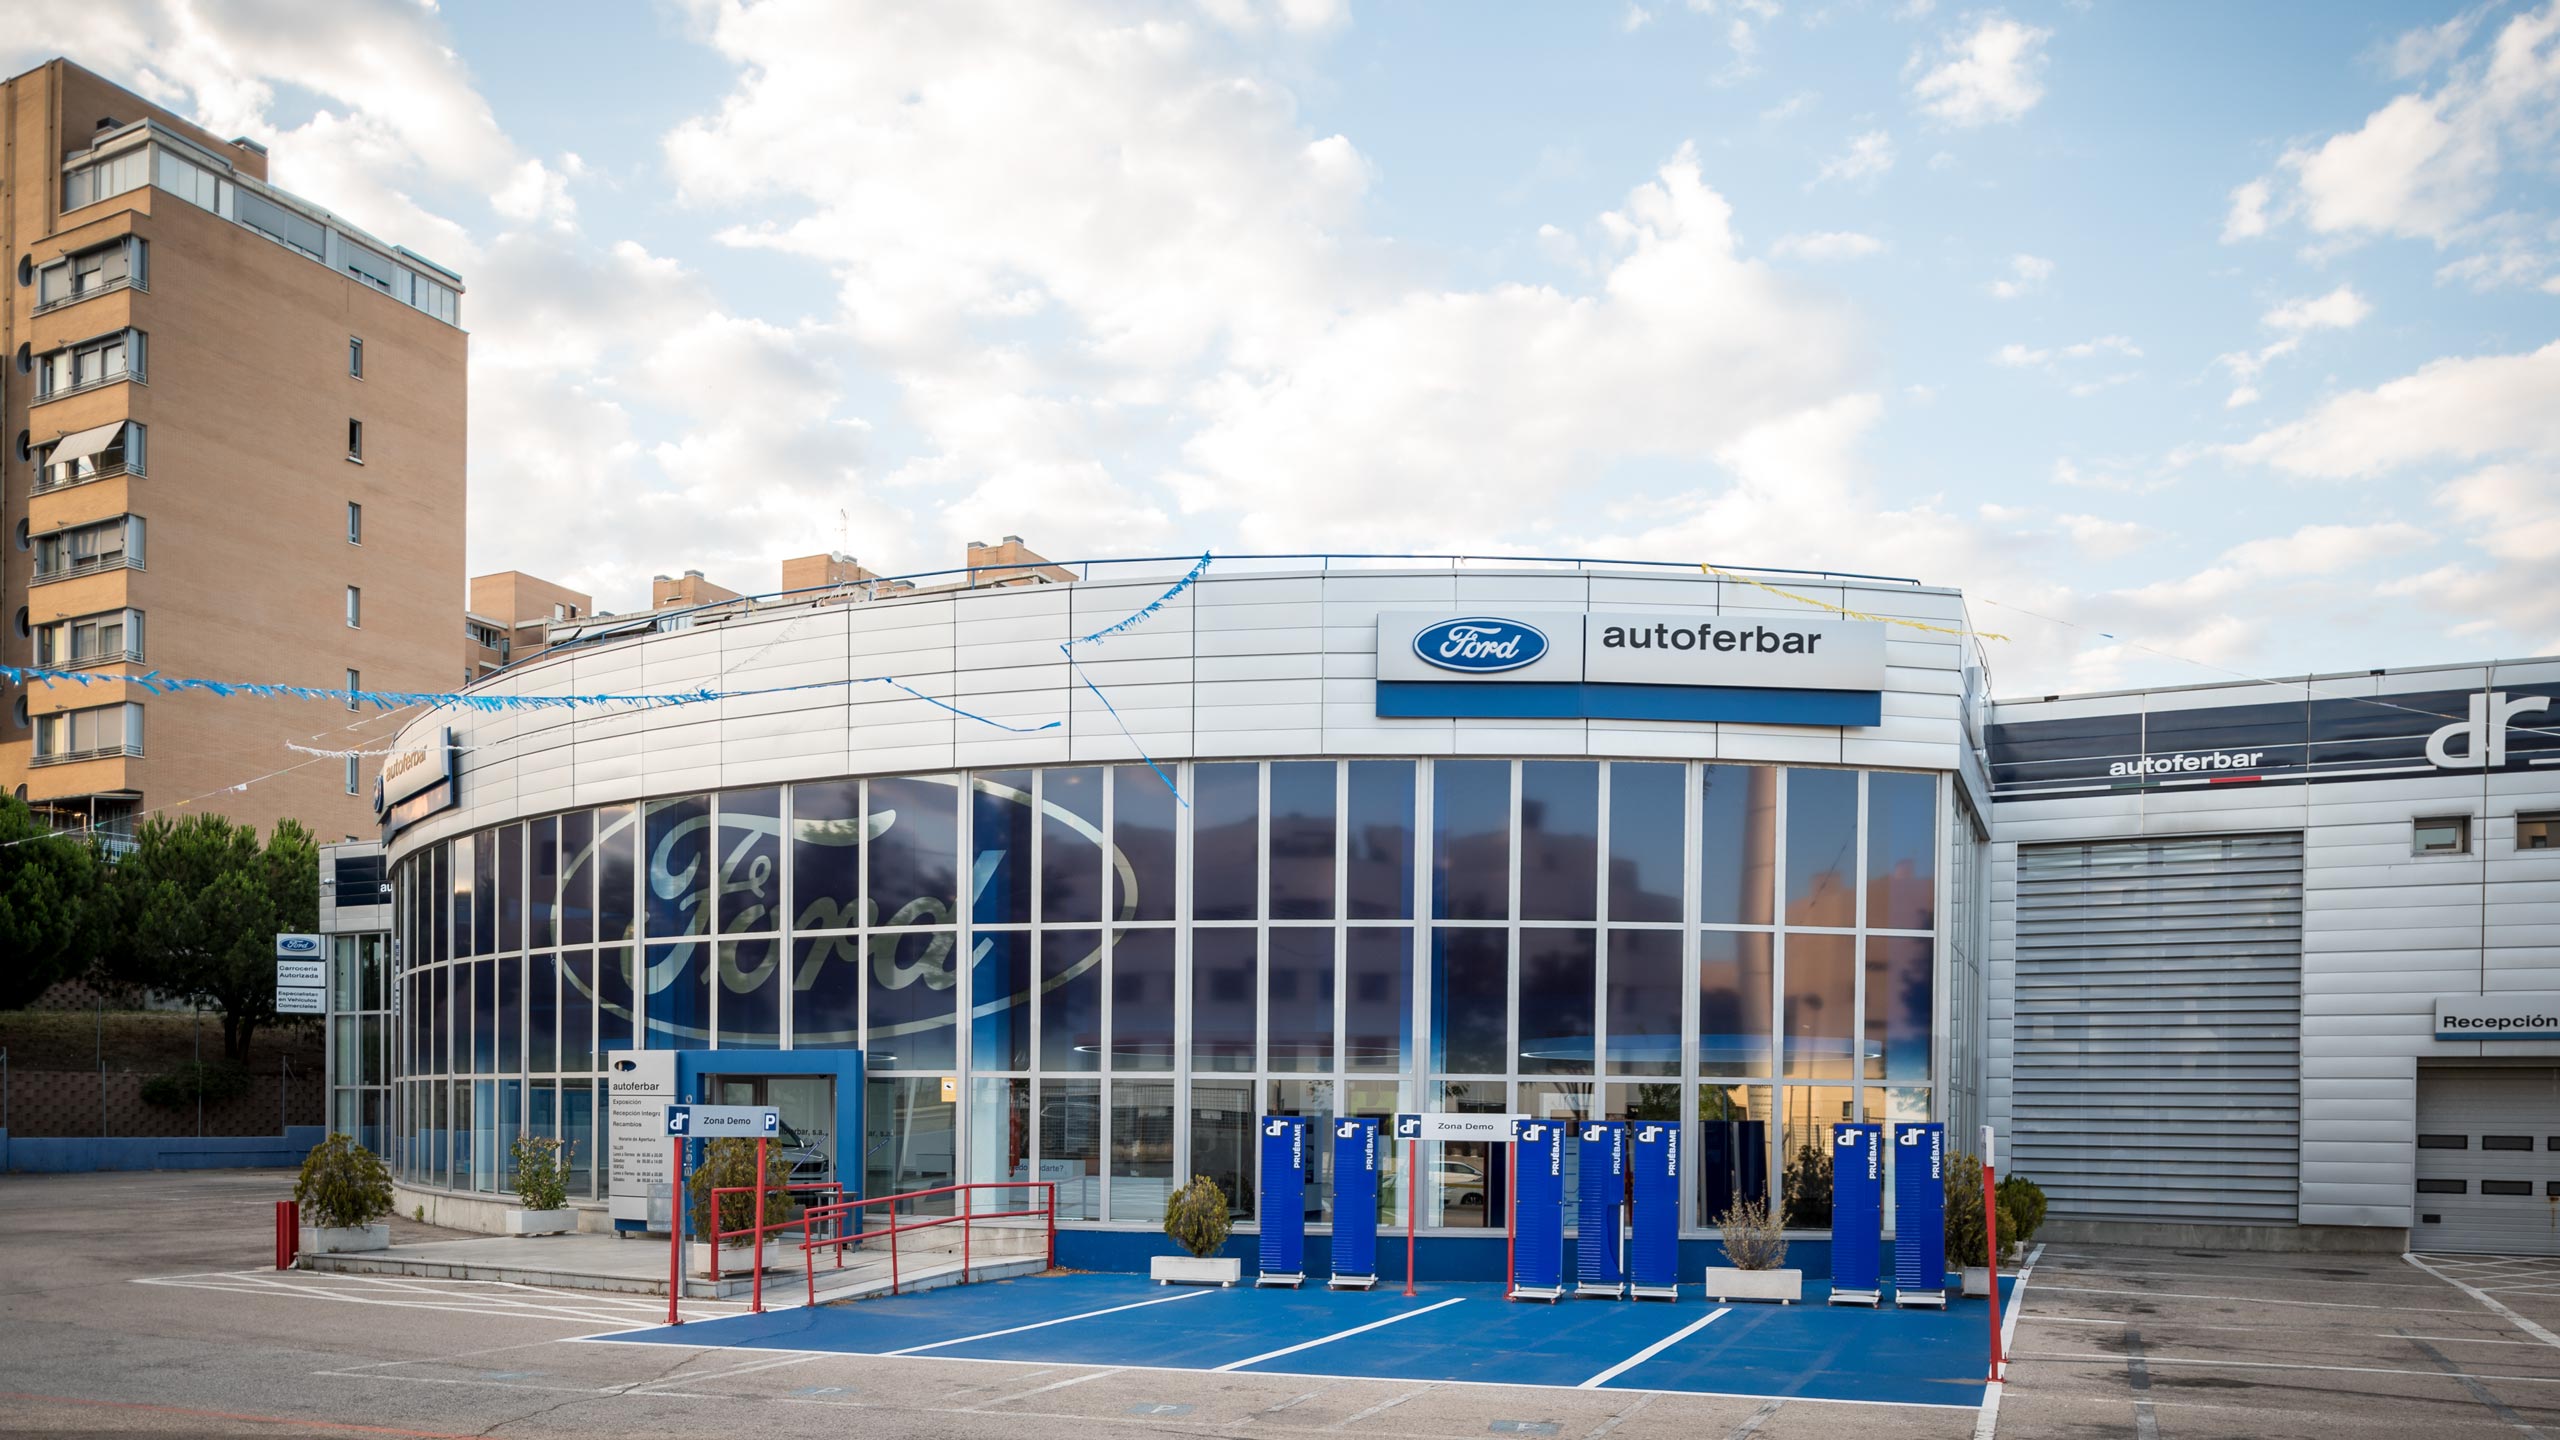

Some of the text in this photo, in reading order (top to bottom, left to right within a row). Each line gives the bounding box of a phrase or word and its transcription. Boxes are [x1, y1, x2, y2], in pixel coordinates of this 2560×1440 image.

[1440, 625, 1522, 659] Ford
[1602, 622, 1822, 655] autoferbar
[385, 745, 428, 782] autoferbar
[2109, 752, 2263, 776] autoferbar
[619, 808, 1007, 995] Ford
[287, 940, 309, 949] Ford
[2443, 1014, 2558, 1030] Recepción
[613, 1081, 660, 1091] autoferbar
[613, 1098, 642, 1106] Exposición
[703, 1116, 725, 1125] Zona
[727, 1116, 751, 1125] Demo
[765, 1114, 776, 1130] P
[1437, 1122, 1463, 1130] Zona
[1465, 1122, 1494, 1130] Demo
[1292, 1123, 1302, 1169] PRUÉBAME
[1364, 1125, 1374, 1171] PRUÉBAME
[1551, 1127, 1561, 1176] PRUÉBAME
[1611, 1128, 1622, 1175] PRUÉBAME
[1666, 1129, 1677, 1176] PRUÉBAME
[1866, 1131, 1878, 1180] PRUÉBAME
[1929, 1130, 1940, 1179] PRUÉBAME
